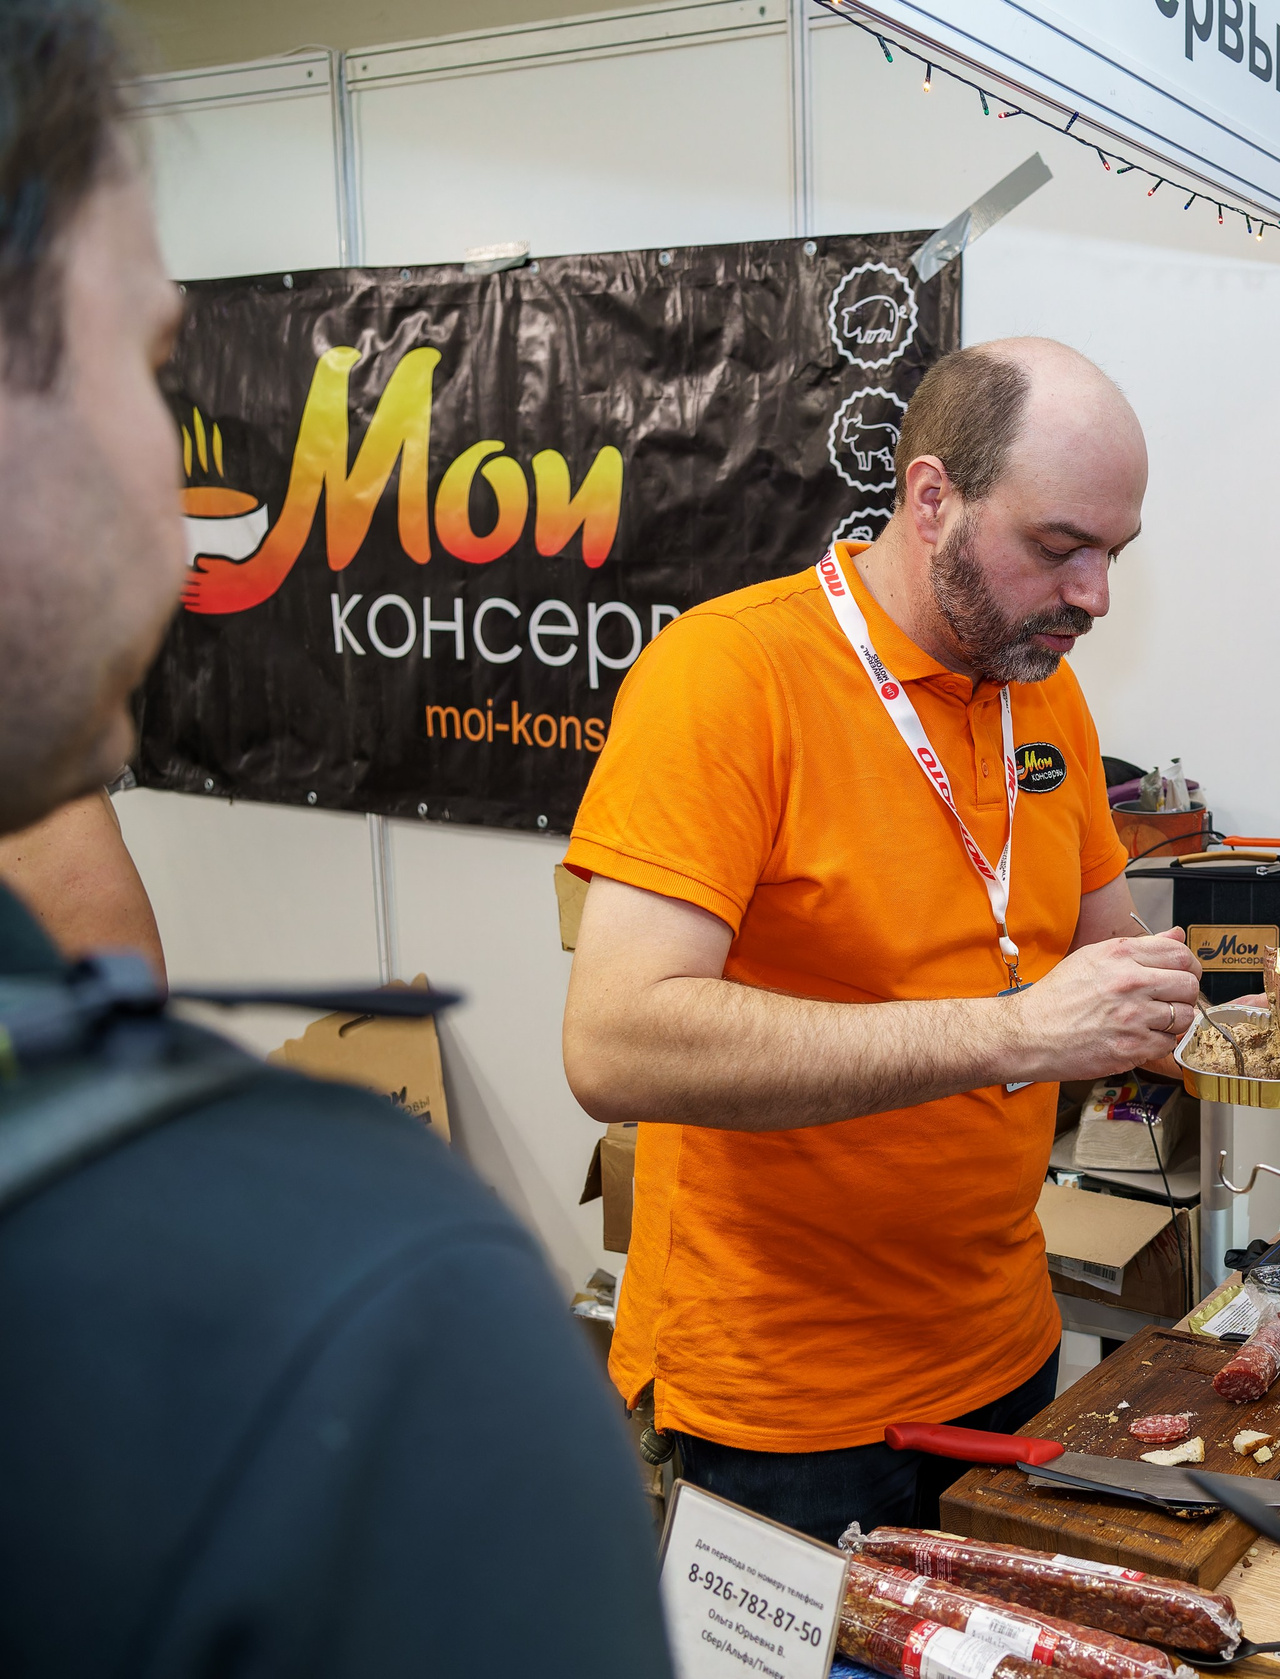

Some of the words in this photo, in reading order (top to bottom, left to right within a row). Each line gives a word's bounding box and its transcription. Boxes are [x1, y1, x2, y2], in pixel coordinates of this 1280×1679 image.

[250, 346, 623, 600] Мои
[872, 653, 890, 682] MOTORS
[425, 698, 606, 753] moi-kons
[1021, 751, 1053, 775] Мои
[1031, 768, 1064, 783] консервы
[1213, 935, 1258, 957] Мои
[695, 1538, 711, 1552] Для
[711, 1548, 747, 1571] перевода
[746, 1566, 757, 1576] по
[757, 1571, 786, 1593] номеру
[787, 1586, 825, 1611] телефона
[687, 1562, 823, 1648] 8-926-782-87-50
[708, 1608, 735, 1630] Ольга
[735, 1621, 776, 1653] Юрьевна
[777, 1645, 787, 1659] В.
